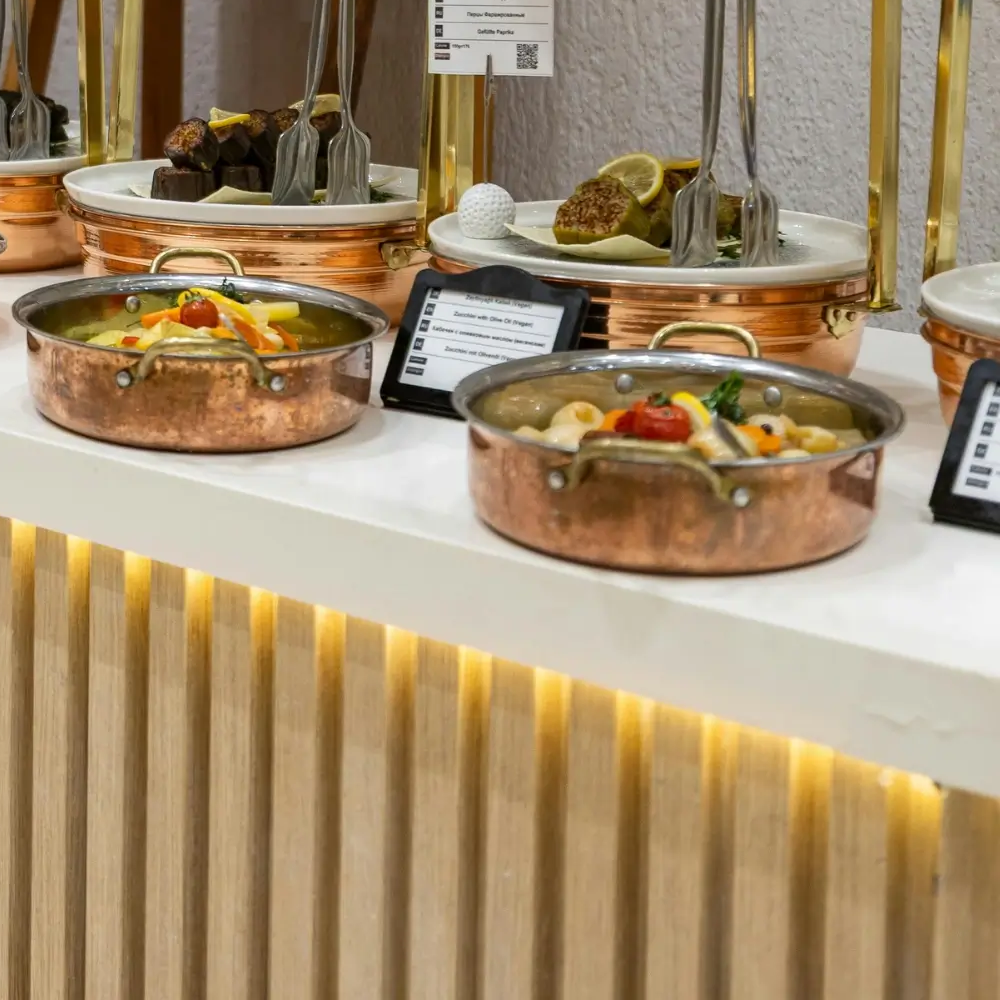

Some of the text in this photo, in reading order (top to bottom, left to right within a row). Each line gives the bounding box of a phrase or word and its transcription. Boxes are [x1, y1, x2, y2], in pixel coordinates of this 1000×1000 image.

[453, 311, 477, 320] Zucchini
[512, 319, 534, 328] (Vegan)
[444, 345, 468, 355] Zucchini
